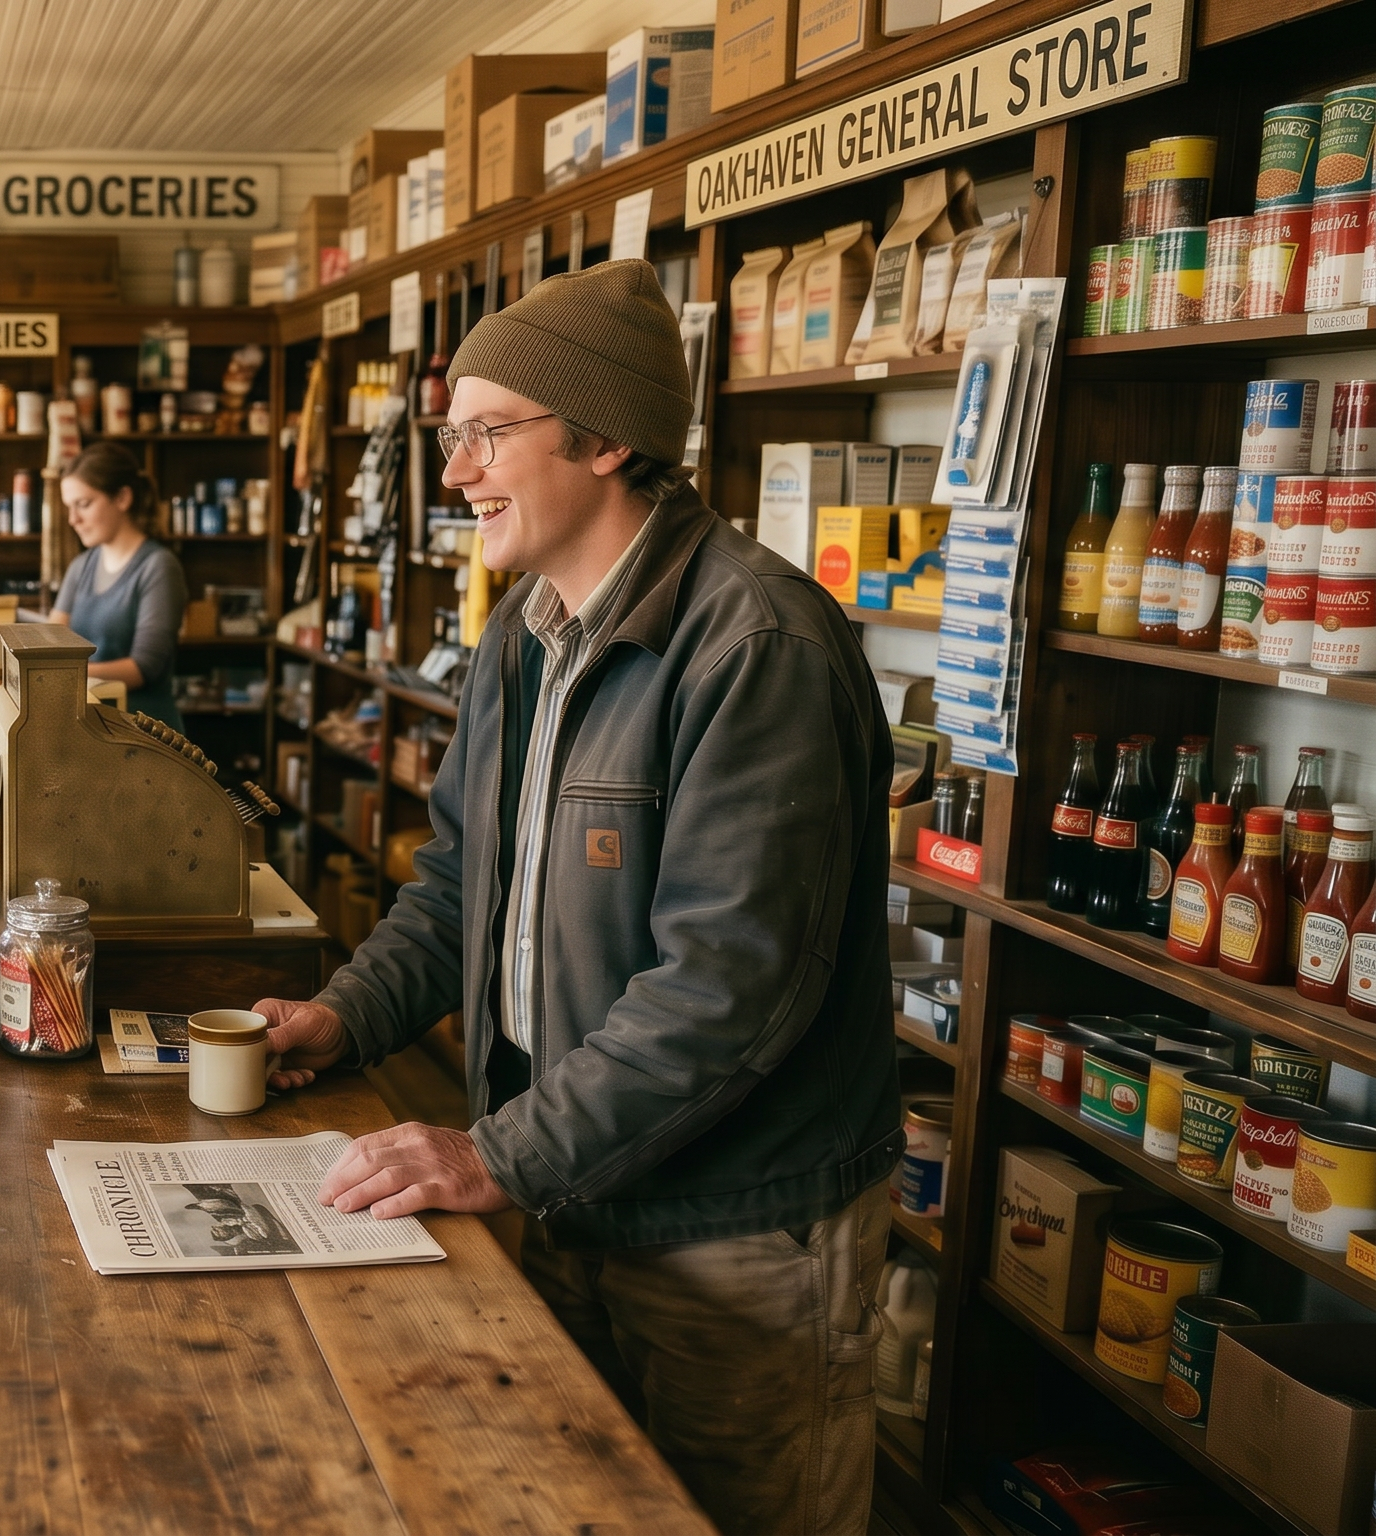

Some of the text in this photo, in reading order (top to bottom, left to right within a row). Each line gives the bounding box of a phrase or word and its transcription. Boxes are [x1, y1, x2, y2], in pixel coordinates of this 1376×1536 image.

[697, 2, 1152, 215] OAKHAVEN GENERAL STORE
[3, 175, 258, 218] GROCERIES
[95, 1160, 157, 1258] CHRONICLE
